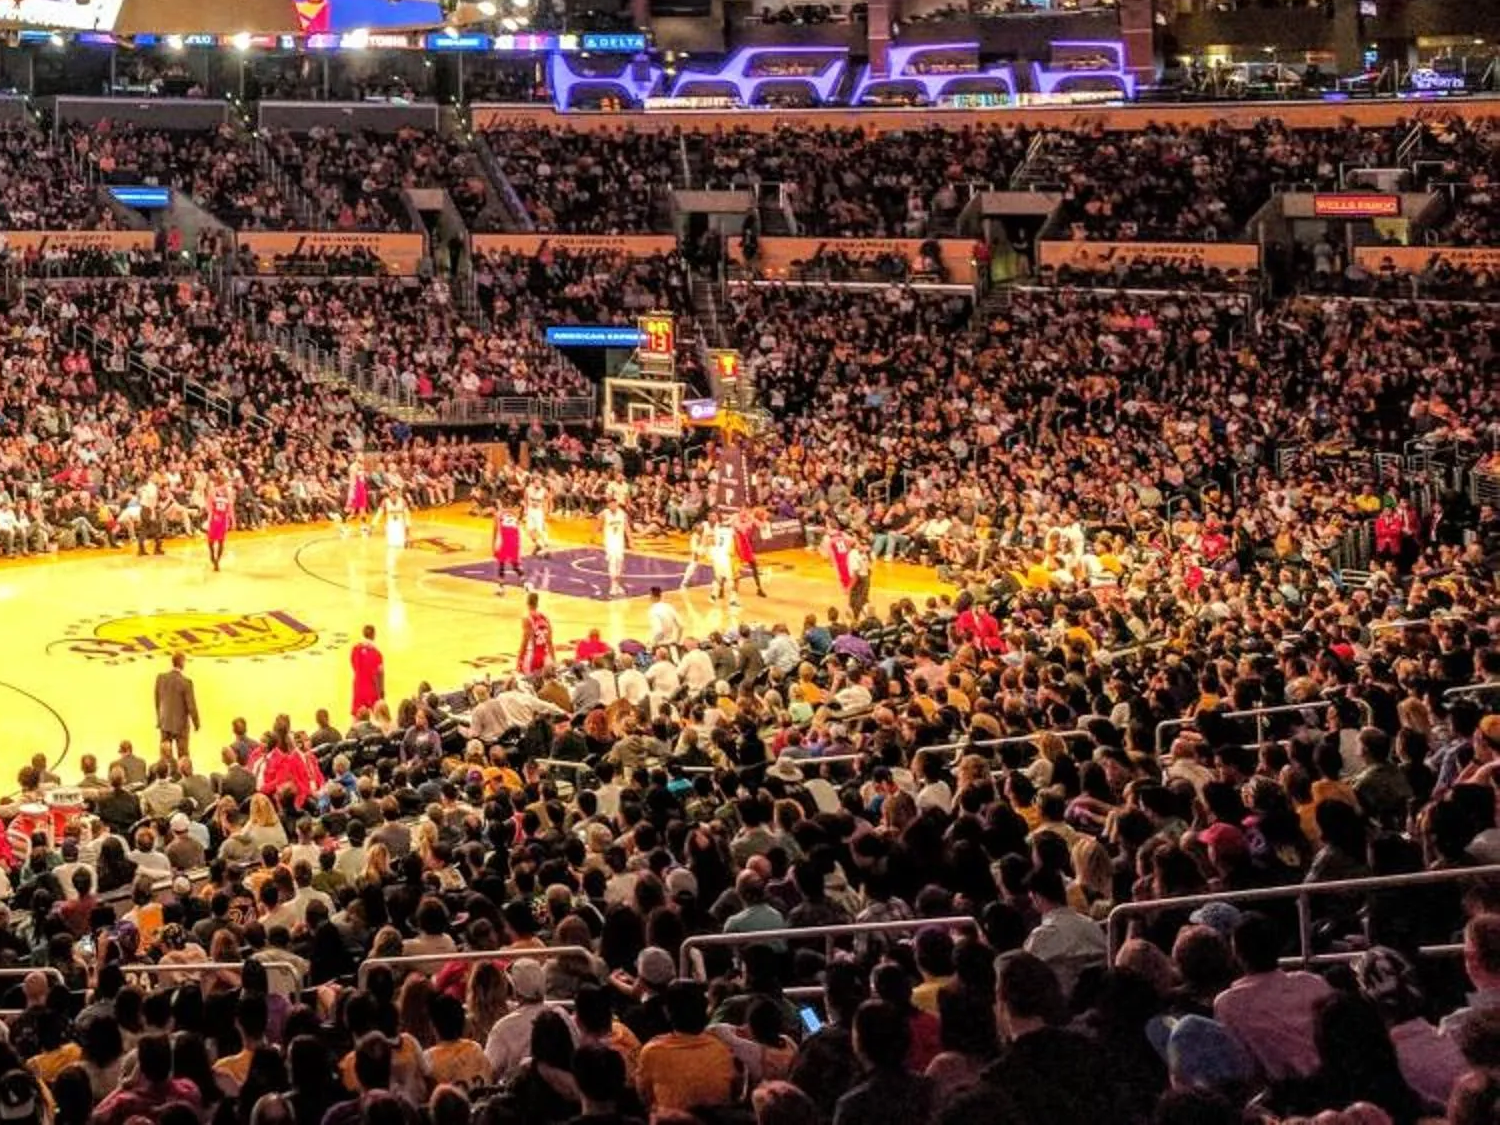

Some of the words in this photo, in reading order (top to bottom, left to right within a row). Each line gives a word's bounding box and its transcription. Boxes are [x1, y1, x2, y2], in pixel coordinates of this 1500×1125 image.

[600, 37, 644, 49] DELTA
[1317, 201, 1355, 210] WELLS
[553, 332, 605, 341] AMERICAN
[650, 334, 669, 351] 13
